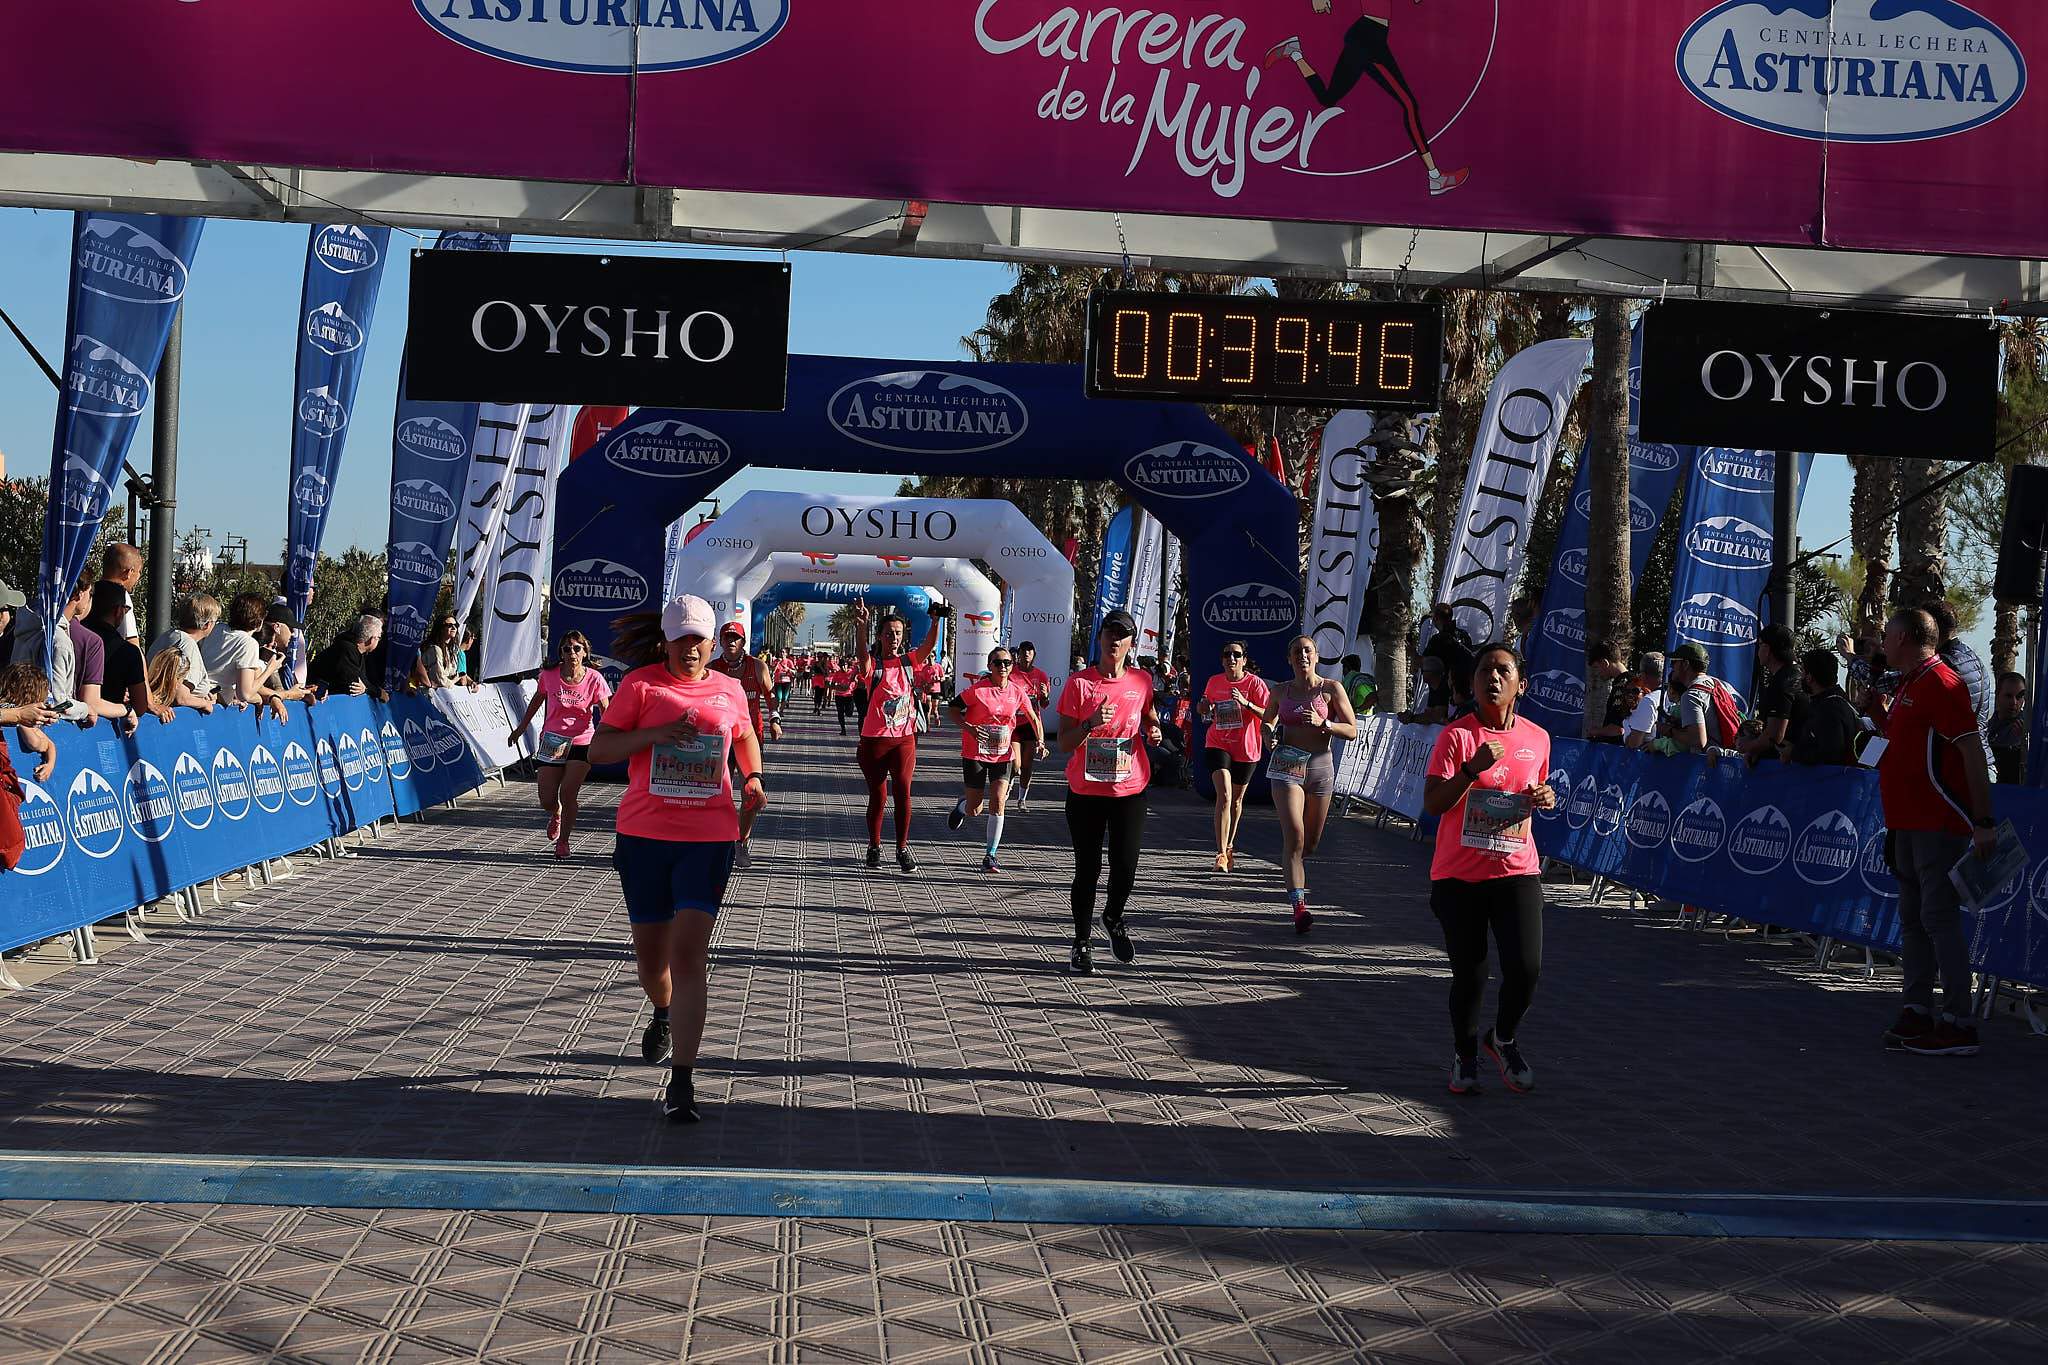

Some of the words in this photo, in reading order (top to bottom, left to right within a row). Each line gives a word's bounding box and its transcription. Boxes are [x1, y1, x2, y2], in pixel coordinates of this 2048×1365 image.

[974, 0, 1246, 71] Carrera
[1759, 27, 1866, 47] CENTRAL
[1878, 34, 1990, 54] LECHERA
[1702, 28, 1999, 103] ASTURIANA
[1037, 65, 1088, 121] de
[1099, 66, 1135, 125] la
[1124, 66, 1346, 198] Mujer
[82, 250, 175, 296] TURIANA
[127, 251, 176, 273] LECHERA
[471, 299, 735, 364] OYSHO
[1113, 309, 1414, 391] 00:39:46
[69, 371, 140, 411] RIANA
[1700, 349, 1947, 412] OYSHO
[842, 392, 1013, 435] ASTURIANA
[874, 392, 937, 404] CENTRAL
[943, 396, 1007, 407] LECHERA
[401, 426, 460, 455] ASTURIANA
[612, 439, 721, 465] ASTURIANA
[633, 437, 674, 446] CENTRAL
[677, 440, 719, 449] LECHERA
[1628, 444, 1671, 467] RIANA
[1135, 462, 1242, 484] ASTURIANA
[1704, 453, 1775, 481] ASTURIA
[393, 488, 449, 518] ASTURIANA
[801, 505, 957, 541] OYSHO
[706, 537, 754, 550] OYSHO
[1000, 546, 1047, 558] OYSHO
[391, 558, 438, 579] STURIANA
[557, 576, 642, 600] ASTURIANA
[1022, 612, 1065, 624] OYSHO
[1208, 602, 1293, 622] ASTURIANA
[1678, 608, 1754, 640] ATURIANA
[1545, 615, 1585, 642] ASTUR
[176, 782, 212, 812] ASTURIANA
[215, 775, 249, 803] ASTURIANA
[73, 804, 122, 839] ASTURIANA
[129, 792, 173, 826] ASTURIANA
[23, 820, 63, 850] URIANA
[1674, 818, 1719, 848] ASTURIANA
[1731, 827, 1785, 859] ASTURIANA
[1795, 834, 1852, 868] ASTURIANA
